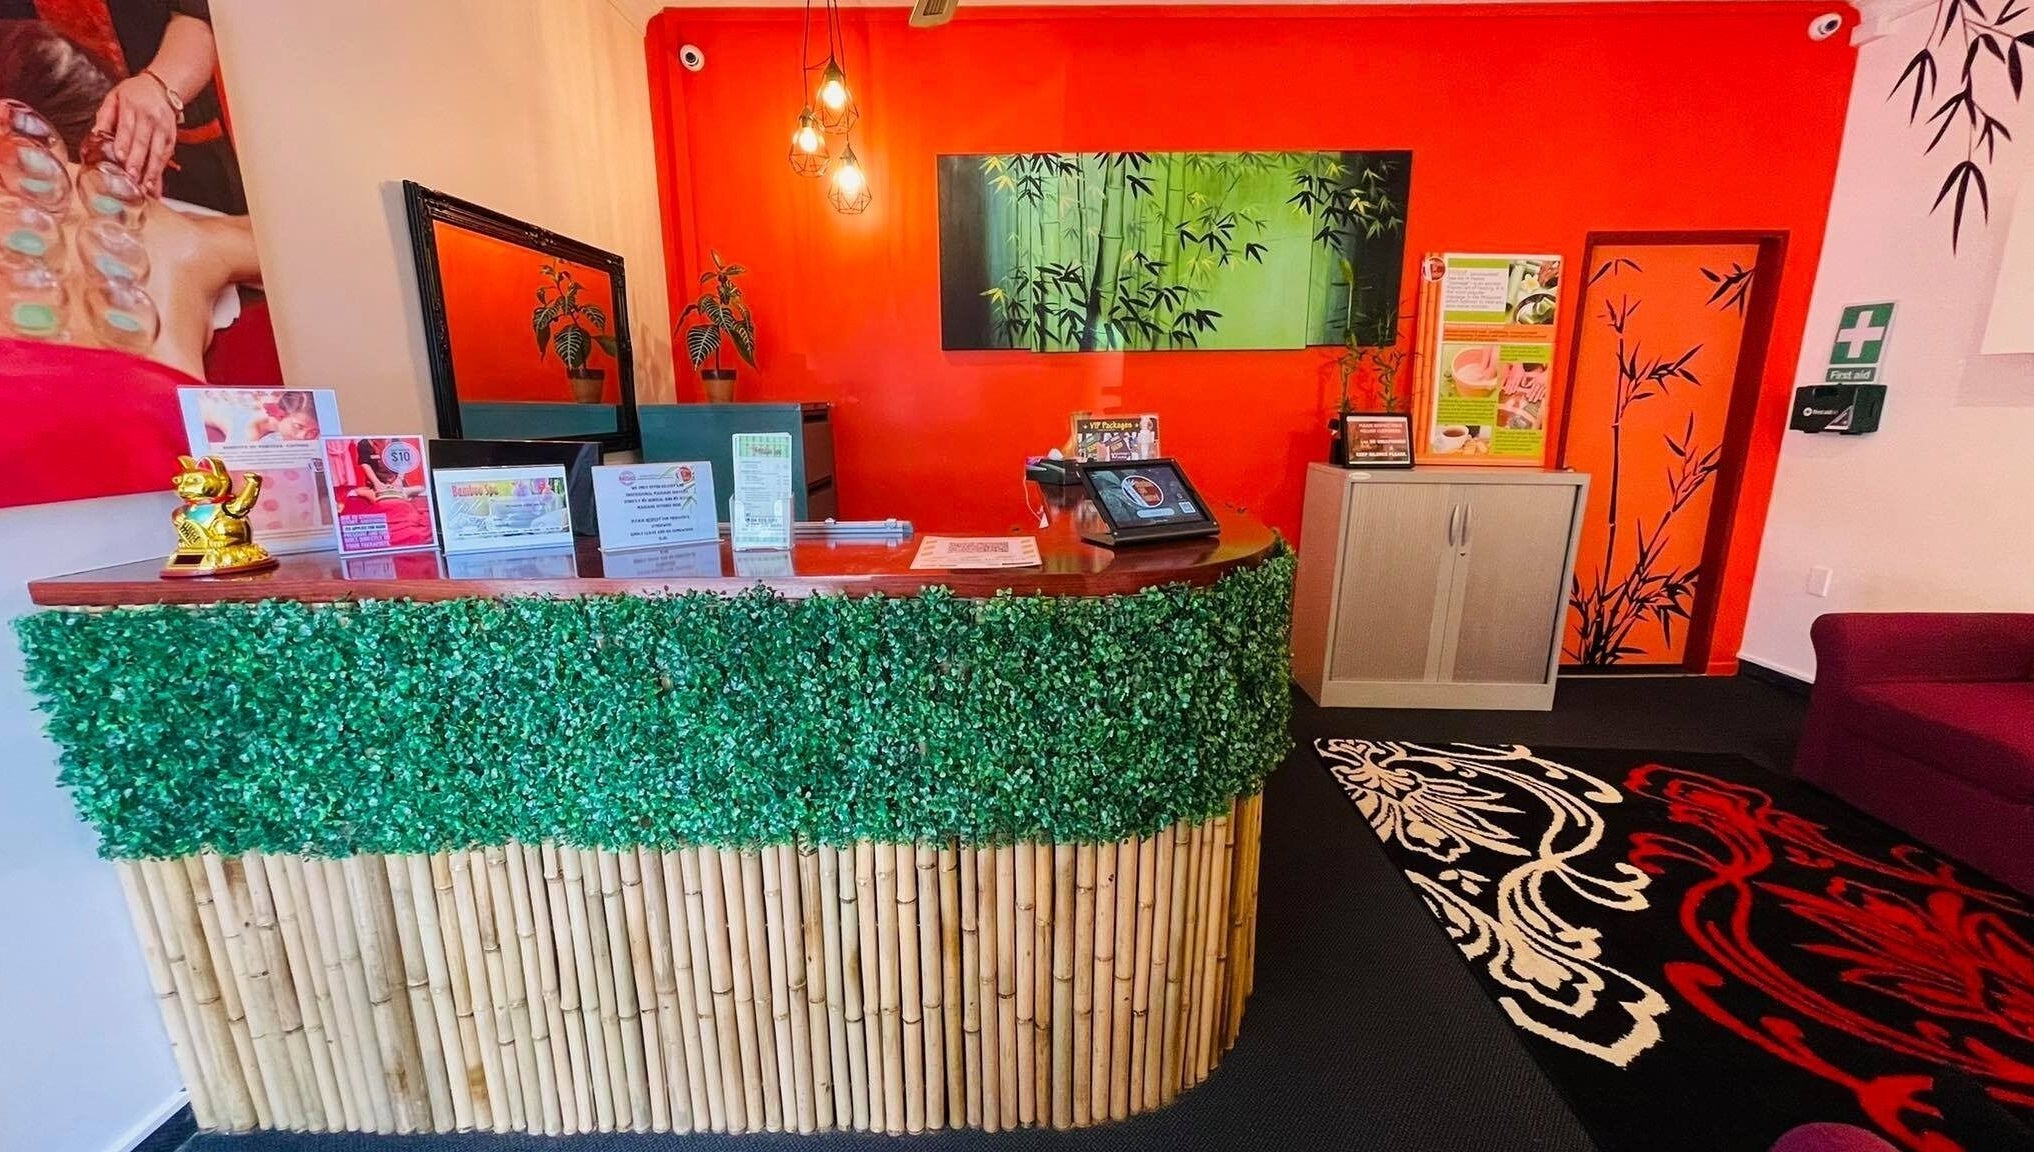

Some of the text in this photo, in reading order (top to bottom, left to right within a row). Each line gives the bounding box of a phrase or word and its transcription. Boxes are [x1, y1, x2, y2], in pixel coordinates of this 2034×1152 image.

[1830, 369, 1871, 380] First aid
[1090, 421, 1102, 429] VIP
[1102, 421, 1133, 431] Packages
[391, 451, 411, 463] $10
[451, 484, 499, 497] Bamboo Spa
